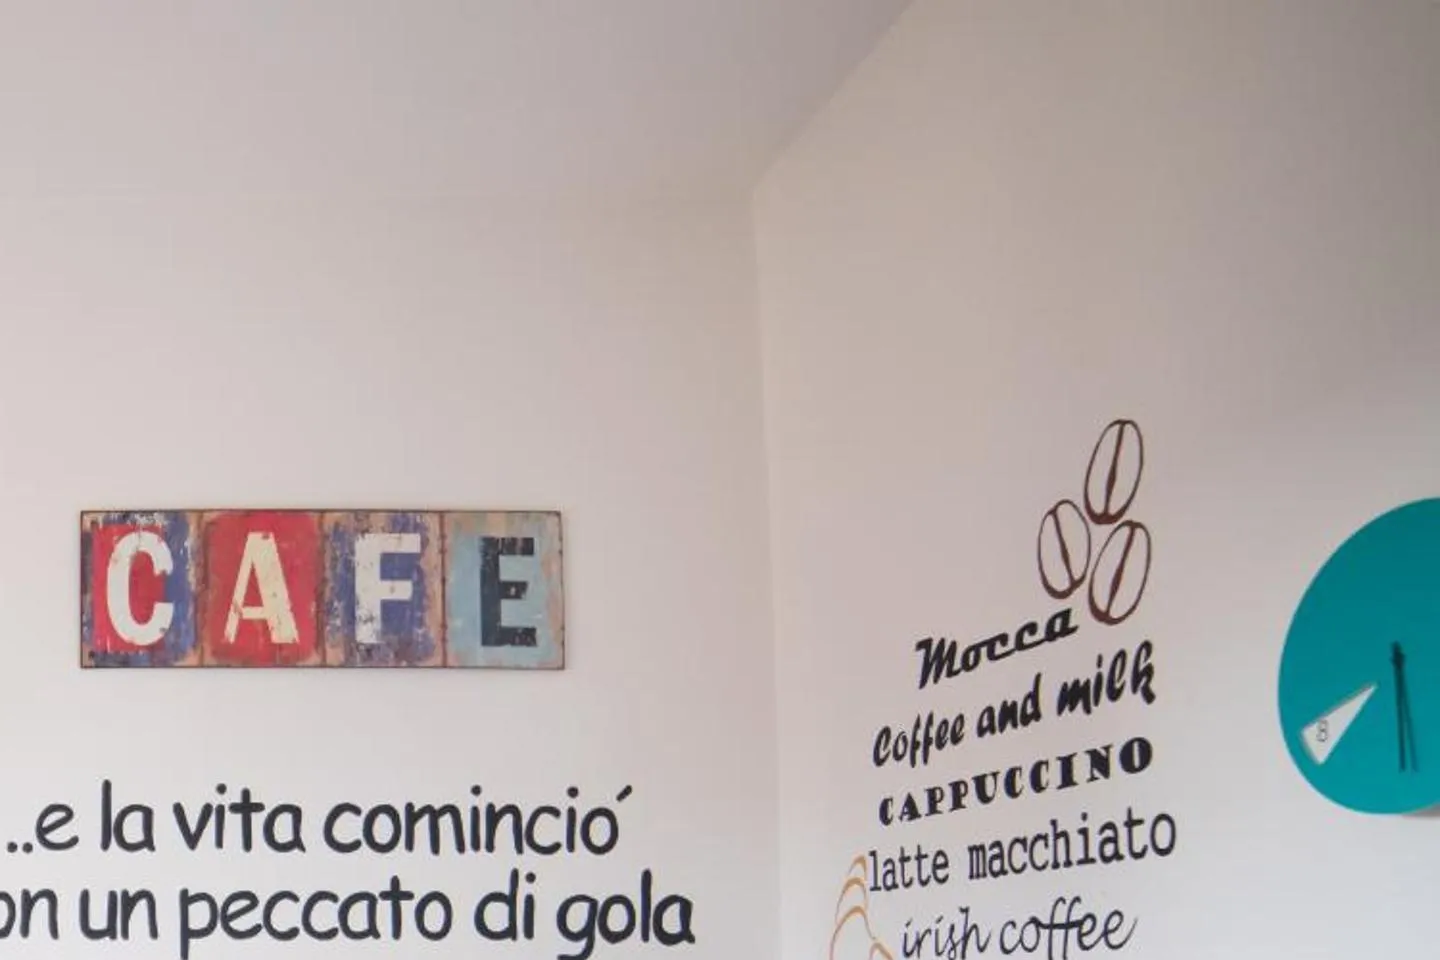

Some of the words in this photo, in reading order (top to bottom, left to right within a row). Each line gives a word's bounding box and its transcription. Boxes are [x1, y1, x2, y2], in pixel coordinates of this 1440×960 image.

[106, 530, 538, 648] CAFE
[914, 606, 1080, 690] Mocca
[871, 710, 966, 769] Coffee
[976, 671, 1043, 739] and
[1055, 639, 1157, 717] milk
[99, 778, 157, 854] la
[171, 782, 307, 854] vita
[877, 736, 1154, 827] CAPPUCCINO
[867, 843, 951, 893] latte
[966, 807, 1178, 881] macchiato
[78, 888, 160, 941] un
[472, 866, 538, 943] di
